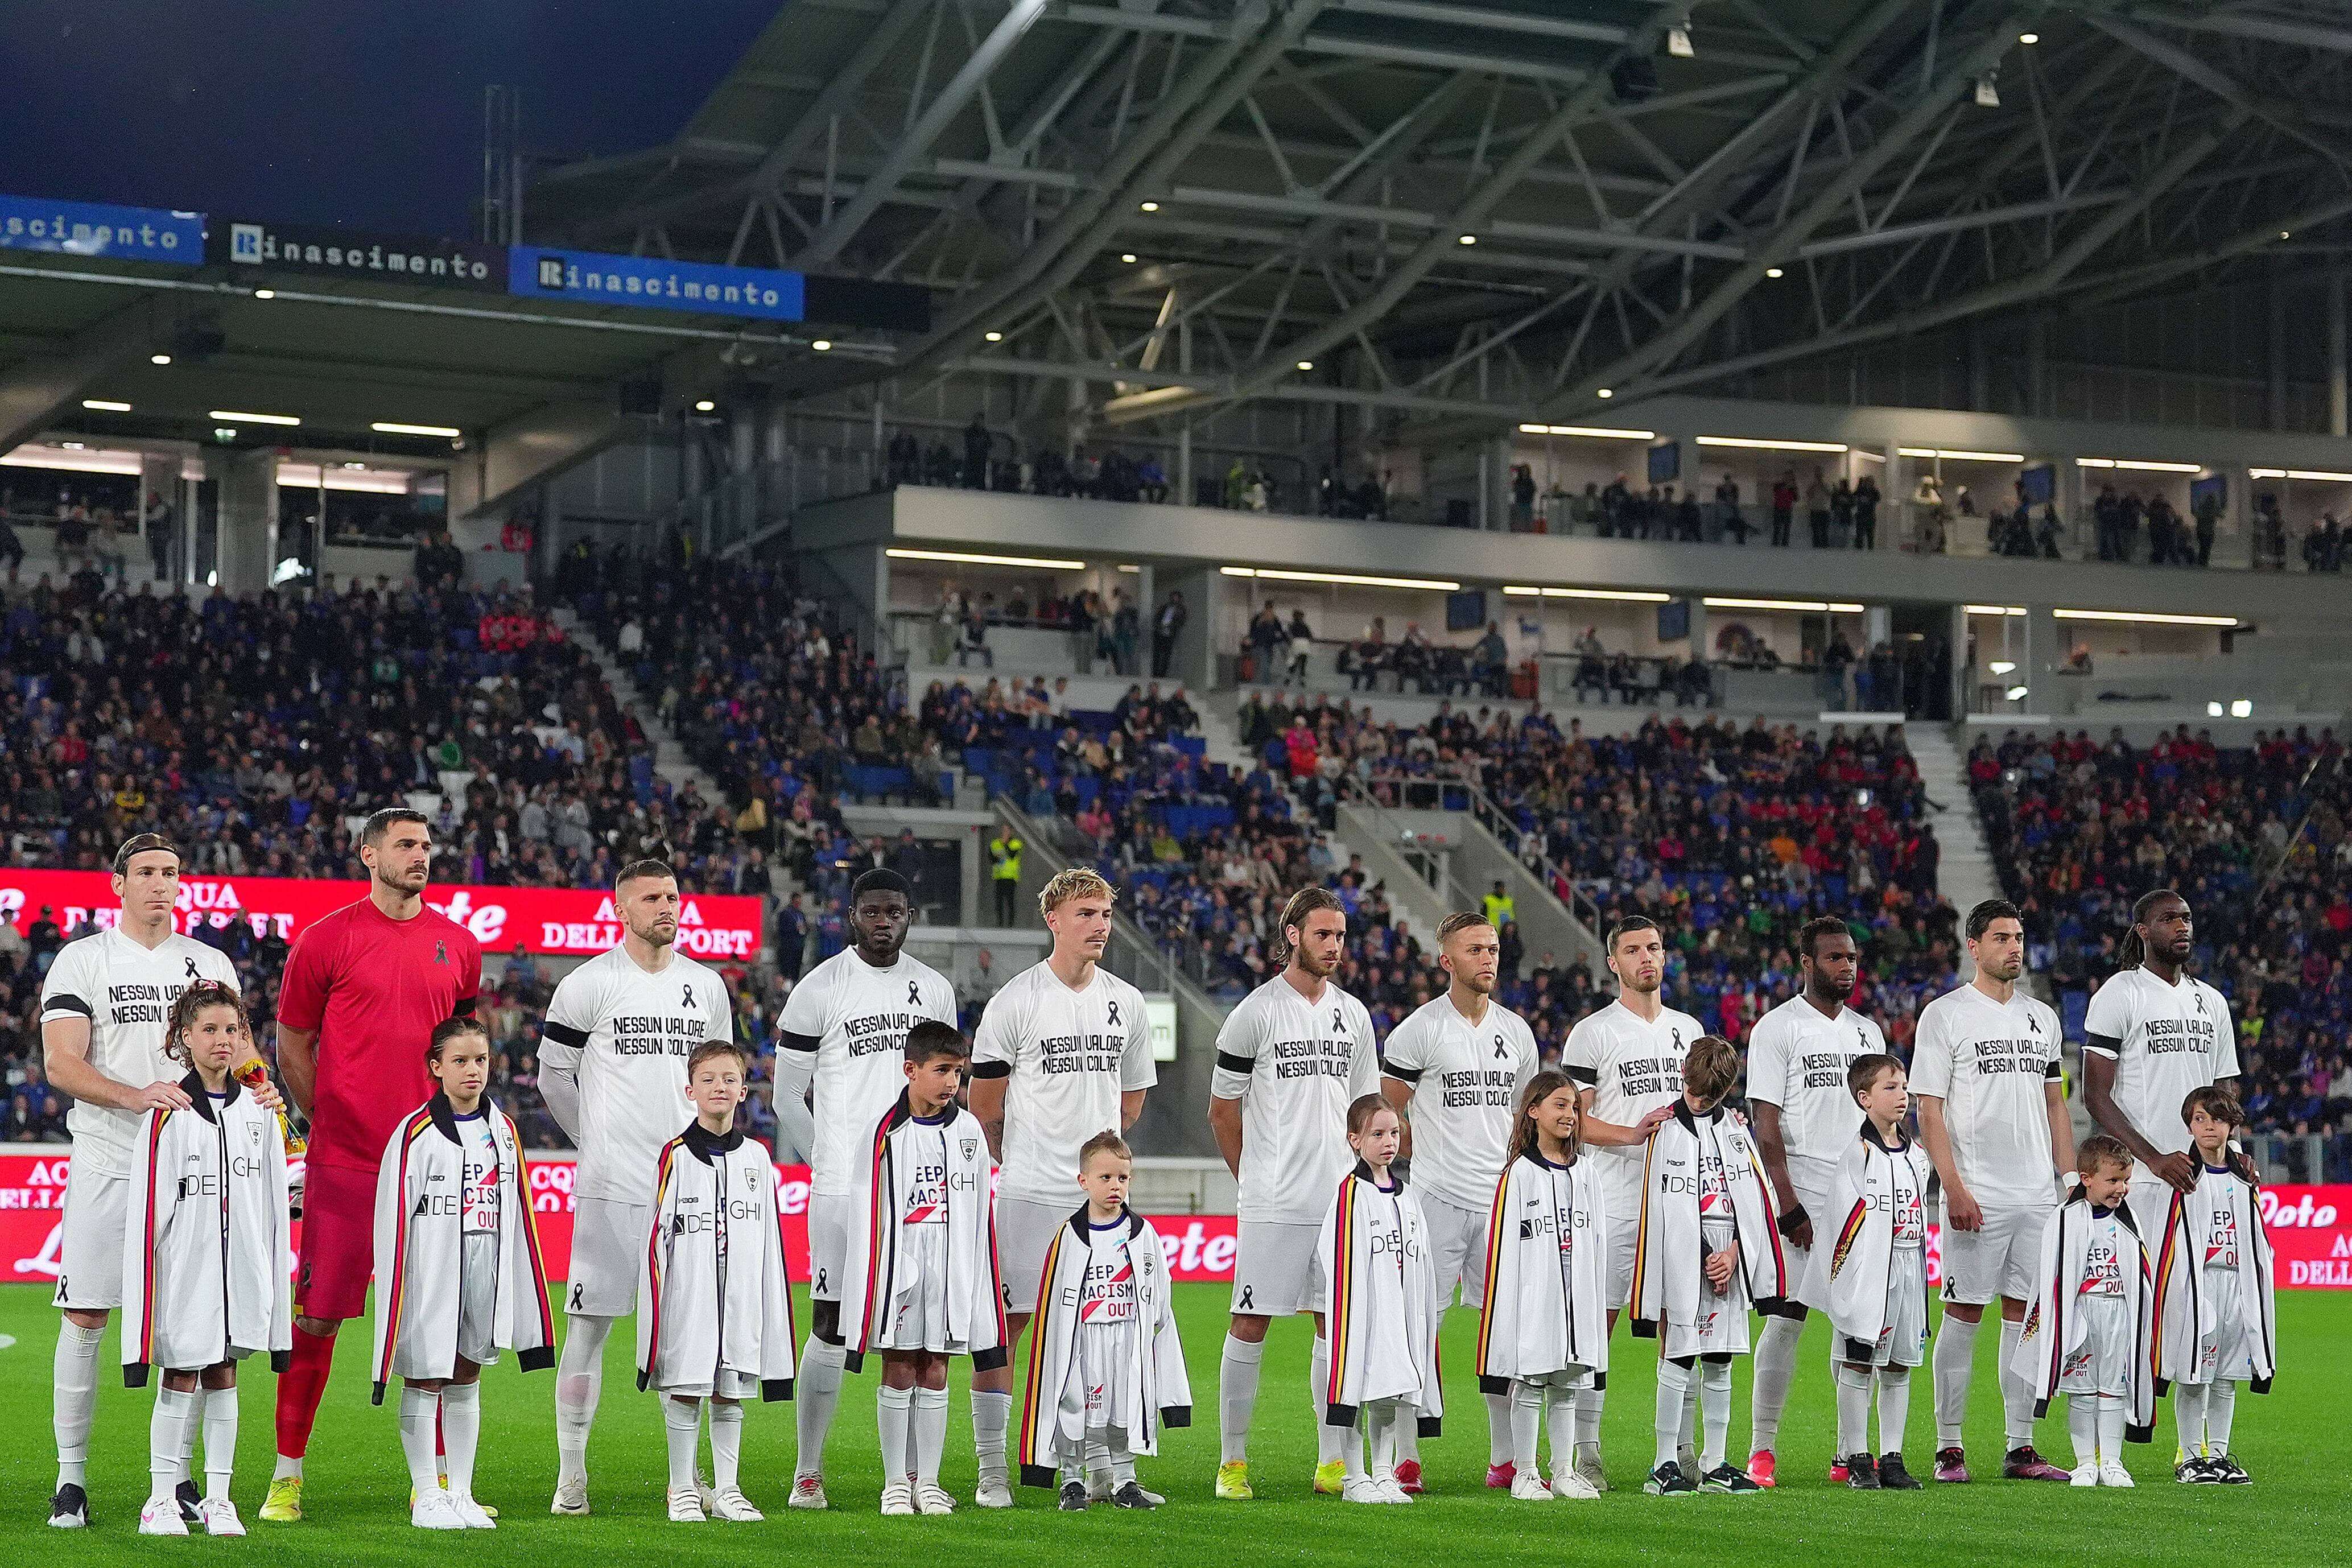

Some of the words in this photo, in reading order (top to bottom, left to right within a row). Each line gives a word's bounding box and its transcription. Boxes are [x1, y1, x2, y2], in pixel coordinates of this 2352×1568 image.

[233, 224, 489, 280] Rinascimento
[539, 258, 779, 307] Rinascimento
[541, 923, 626, 948] DELL
[677, 929, 753, 955] PORT
[108, 985, 160, 1003] NESSUN
[111, 1005, 162, 1025] NESSUN
[613, 1017, 662, 1034] NESSUN
[666, 1017, 705, 1038] VALORE
[844, 1014, 892, 1038] NESSUN
[2145, 1019, 2184, 1037] NESSUN
[614, 1037, 663, 1055] NESSUN
[848, 1034, 893, 1058] NESSUN
[1041, 1035, 1082, 1055] NESSUN
[1085, 1034, 1124, 1053] VALORE
[1274, 1039, 1317, 1059] NESSUN
[1974, 1039, 2014, 1057] NESSUN
[2147, 1037, 2186, 1055] NESSUN
[1042, 1056, 1083, 1075] NESSUN
[1276, 1059, 1318, 1079] NESSUN
[1618, 1058, 1660, 1079] NESSUN
[1802, 1053, 1841, 1071] NESSUN
[1978, 1058, 2016, 1075] NESSUN
[1442, 1070, 1481, 1088] NESSUN
[1621, 1077, 1662, 1097] NESSUN
[1804, 1072, 1843, 1089] NESSUN
[1443, 1091, 1483, 1107] NESSUN
[464, 1164, 483, 1181] EP
[915, 1166, 943, 1183] EEP
[1700, 1157, 1722, 1174] EEP
[188, 1175, 217, 1195] DE
[233, 1156, 261, 1179] GH
[1671, 1177, 1696, 1195] DE
[432, 1195, 457, 1216] DE
[1896, 1189, 1912, 1204] EP
[687, 1212, 712, 1233] DE
[730, 1200, 760, 1221] GHI
[2213, 1211, 2231, 1225] EP
[1160, 1222, 1237, 1272] ete
[2087, 1248, 2110, 1262] EEP
[1087, 1265, 1115, 1281] EEP
[1108, 1302, 1133, 1317] OUT
